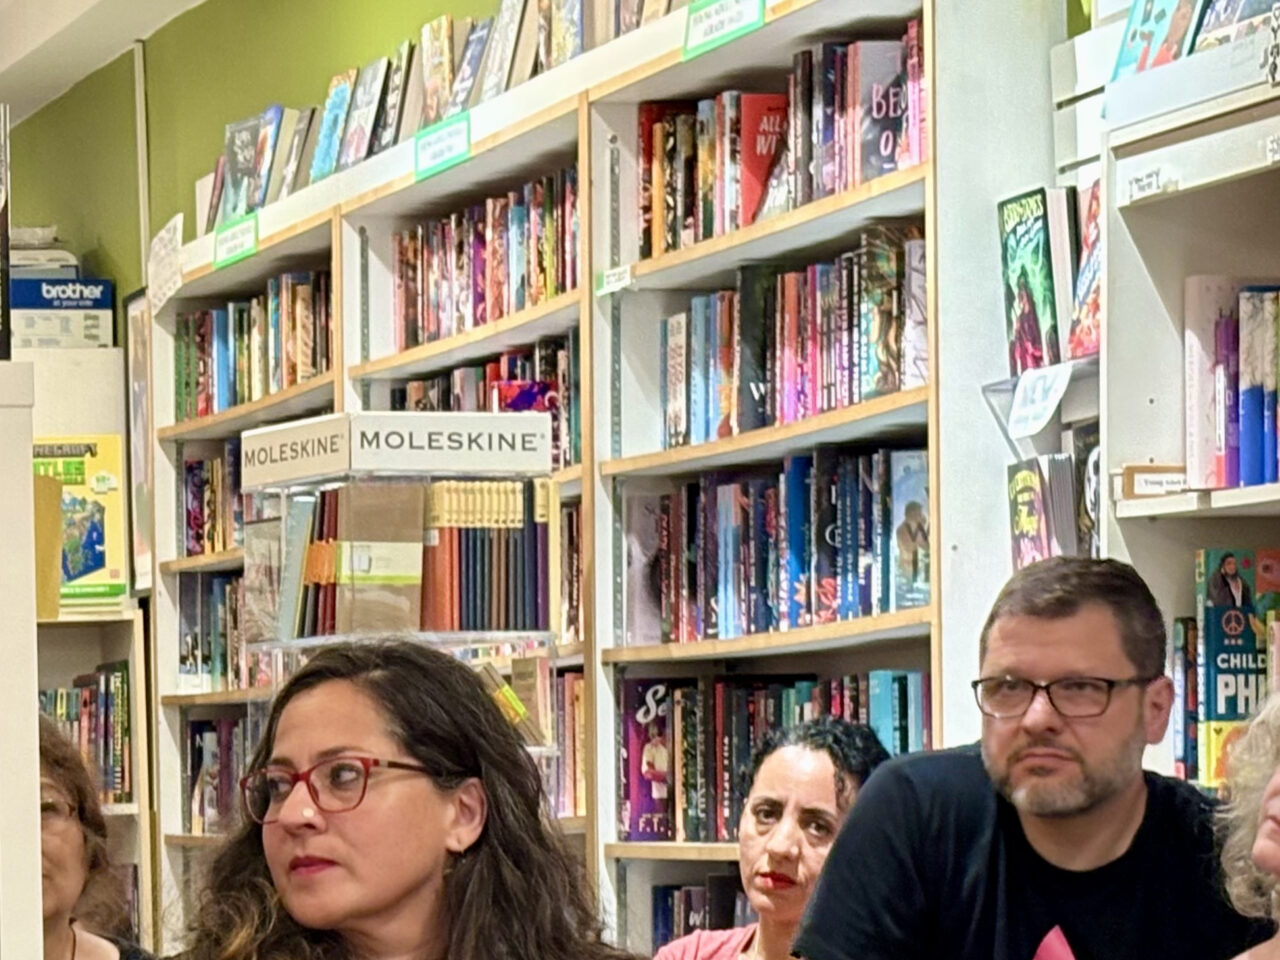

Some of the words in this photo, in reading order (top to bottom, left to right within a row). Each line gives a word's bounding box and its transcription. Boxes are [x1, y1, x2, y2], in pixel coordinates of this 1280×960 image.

[41, 282, 104, 300] brother
[244, 434, 341, 467] MOLESKINE
[360, 430, 538, 452] MOLESKINE
